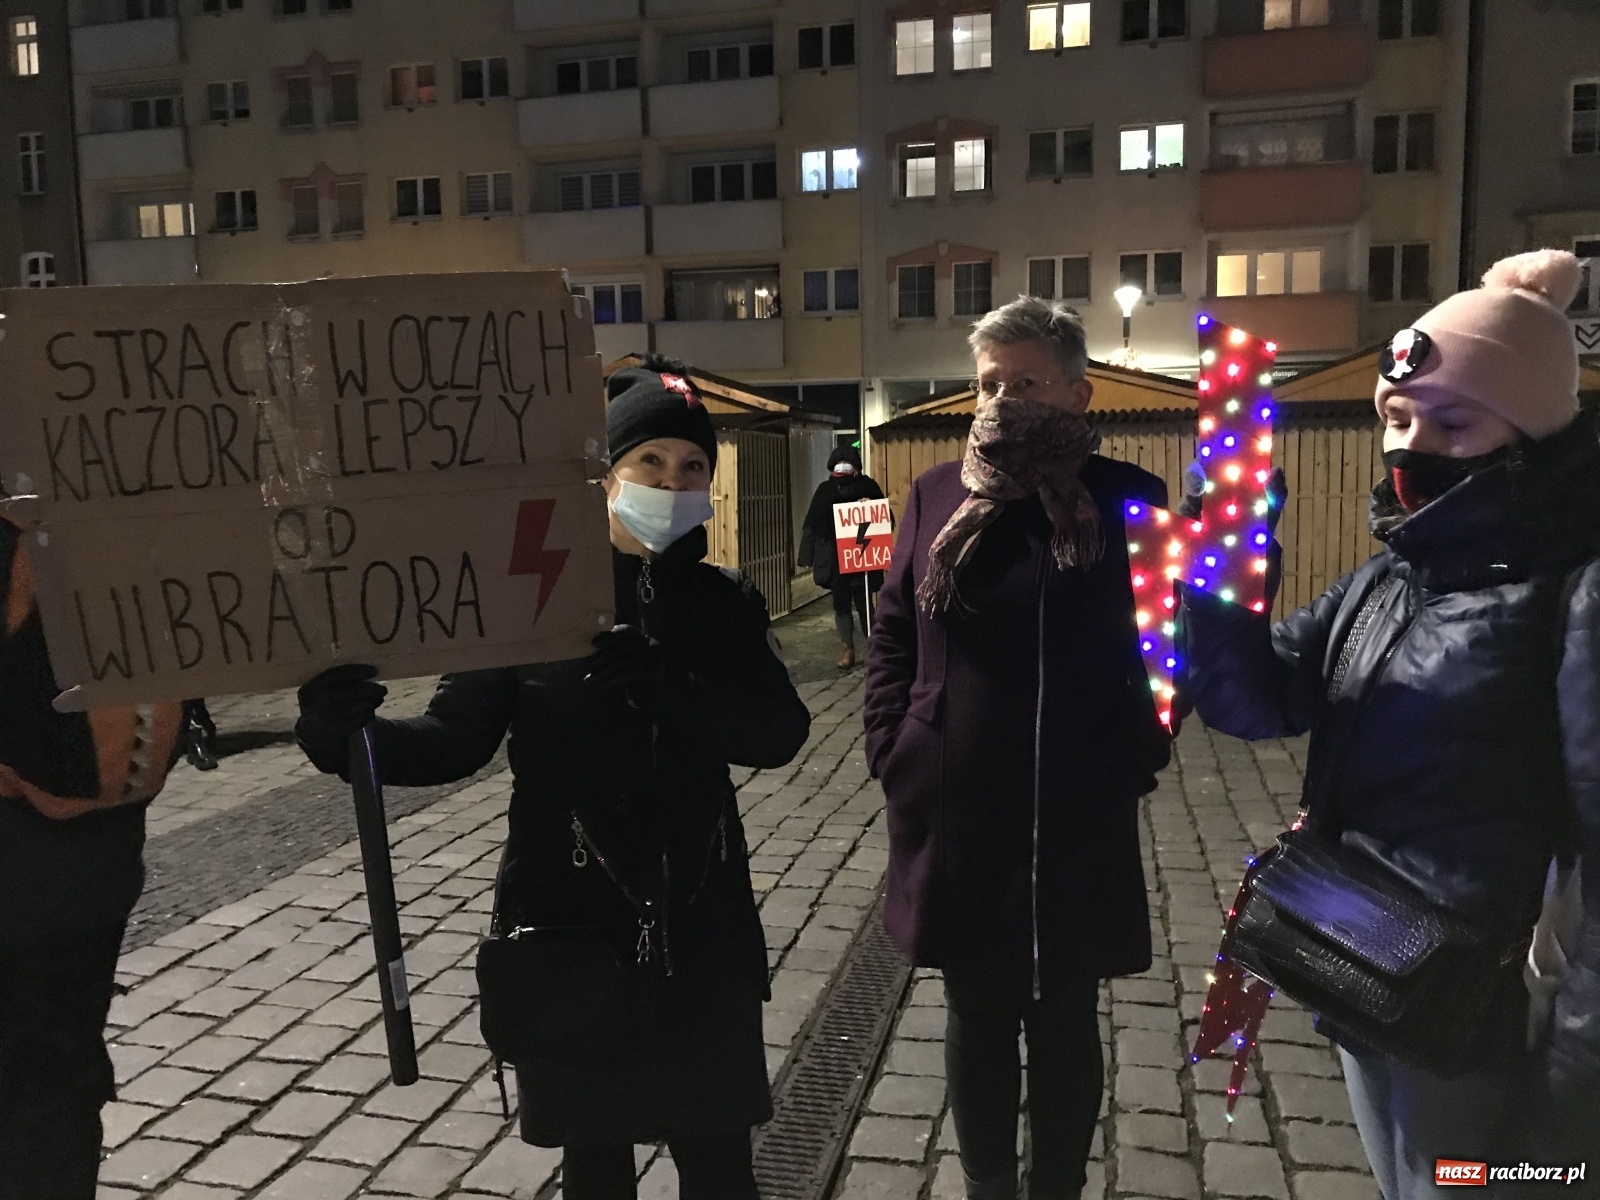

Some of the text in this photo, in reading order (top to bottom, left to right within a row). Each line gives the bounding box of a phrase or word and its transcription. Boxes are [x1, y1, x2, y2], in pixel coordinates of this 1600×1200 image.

[46, 309, 572, 400] STRACH W OCZACH
[42, 393, 533, 501] KACZORA LEPSZY
[274, 507, 355, 559] OD
[838, 503, 890, 526] WOLNA
[844, 546, 891, 568] POLKA
[75, 551, 484, 680] WIBRATORA
